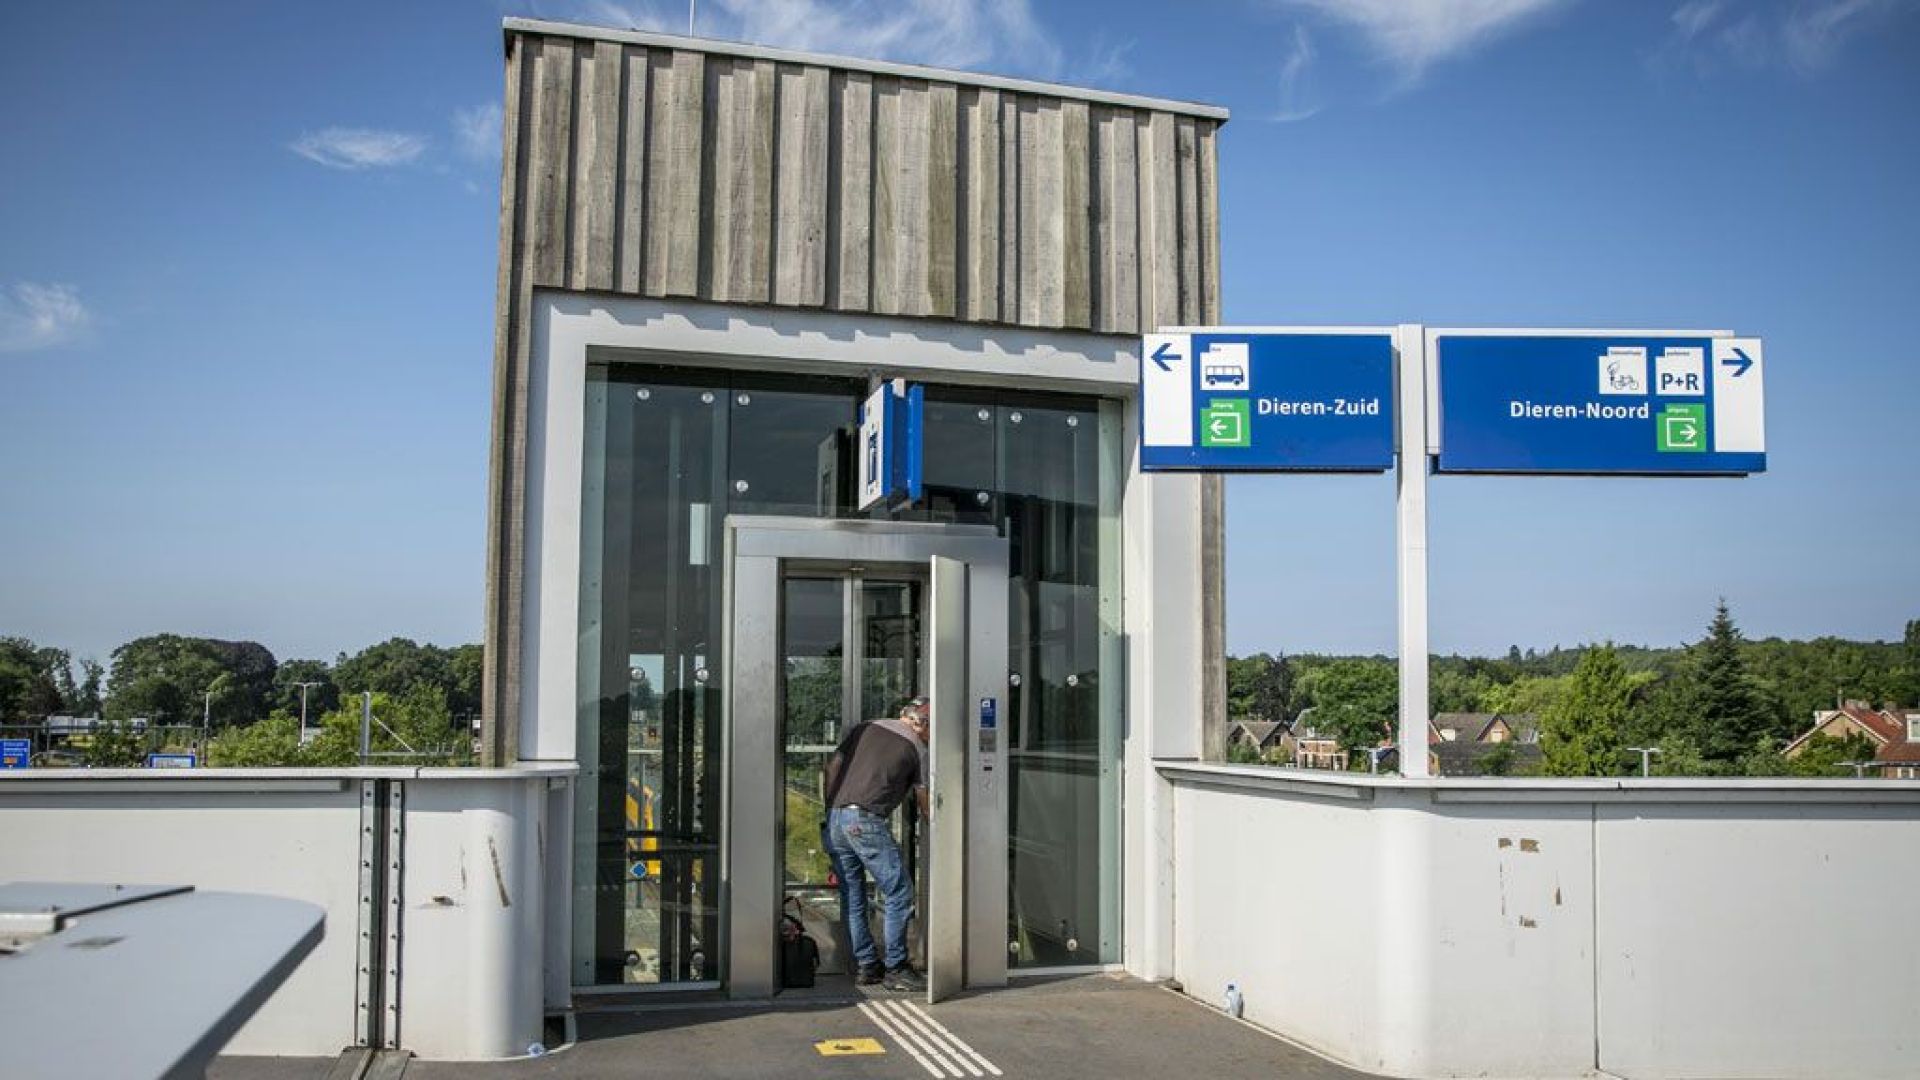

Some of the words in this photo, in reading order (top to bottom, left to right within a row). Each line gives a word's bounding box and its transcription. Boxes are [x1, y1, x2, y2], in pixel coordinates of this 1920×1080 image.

[1661, 372, 1699, 390] P+R
[1258, 397, 1379, 415] Dieren-Zuid
[1510, 401, 1649, 418] Dieren-Noord
